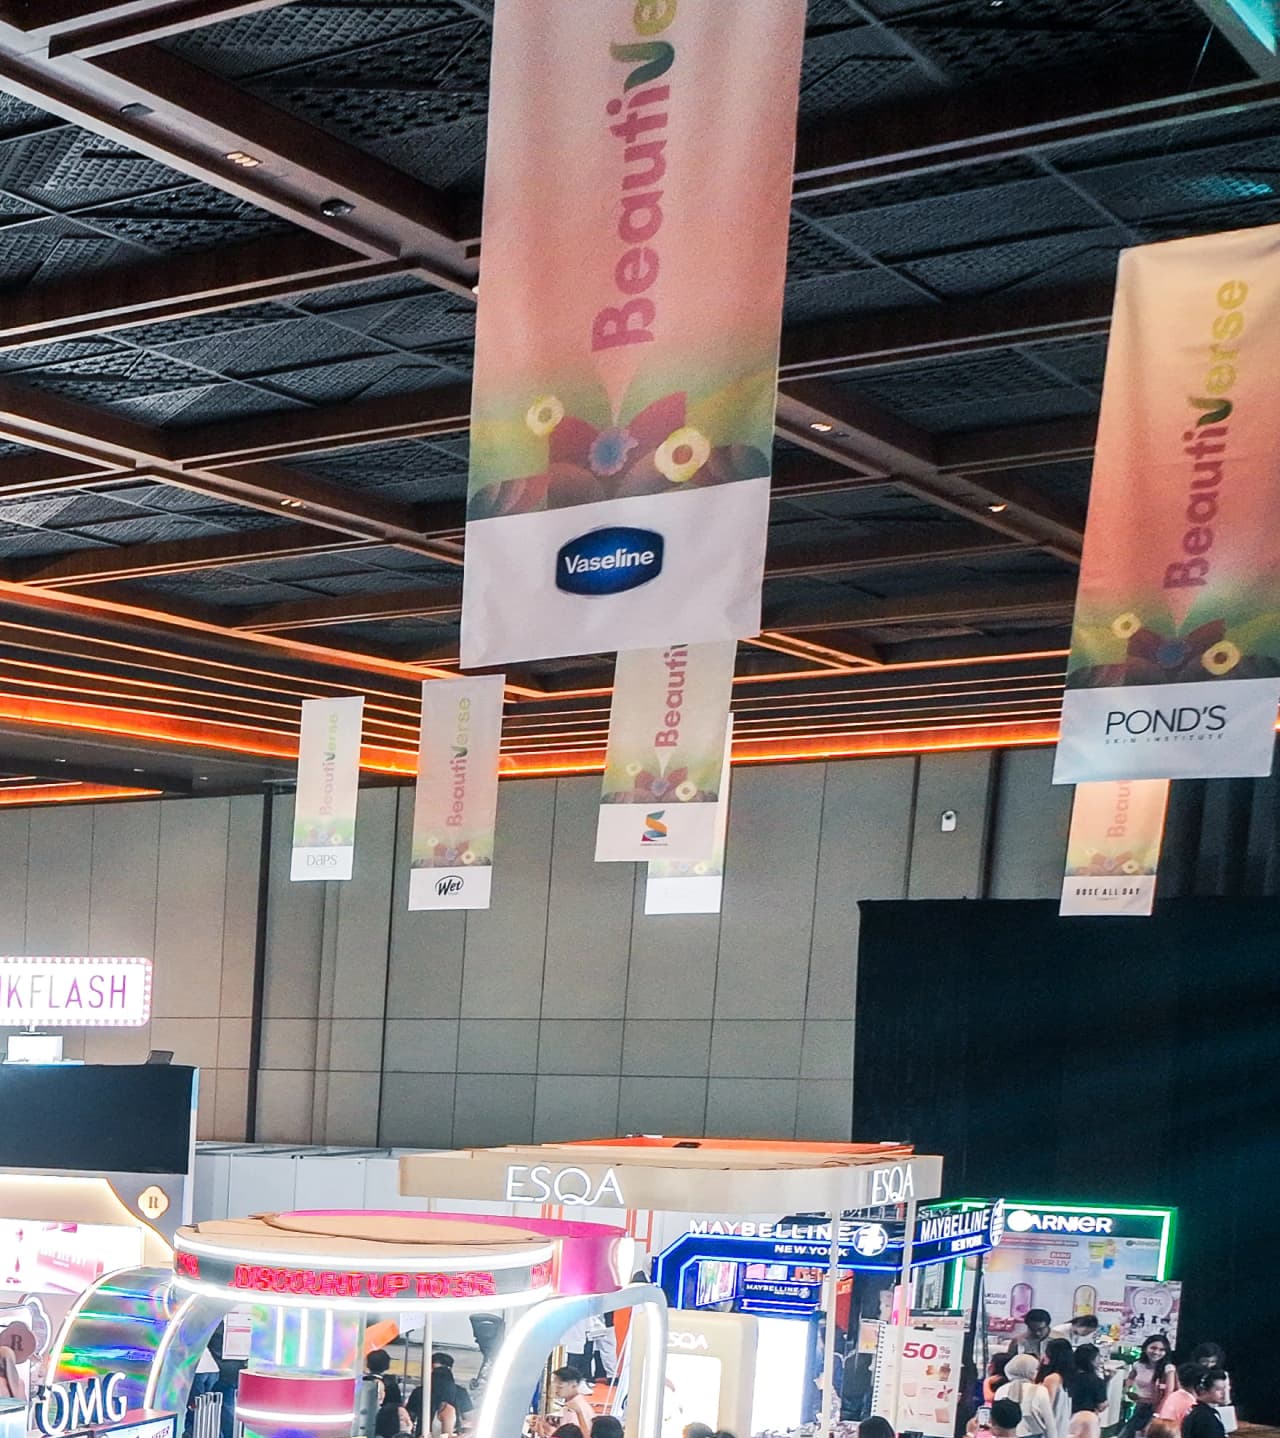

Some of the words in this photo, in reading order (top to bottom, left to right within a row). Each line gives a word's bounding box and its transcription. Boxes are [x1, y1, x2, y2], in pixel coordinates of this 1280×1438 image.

[563, 548, 656, 575] Vaseline
[1105, 705, 1227, 735] POND'S
[505, 1165, 625, 1205] ESQA
[871, 1164, 915, 1206] ESQA
[689, 1219, 856, 1242] MAYBELLINE
[920, 1209, 990, 1243] MAYBELLINE
[36, 1372, 128, 1437] OMG
